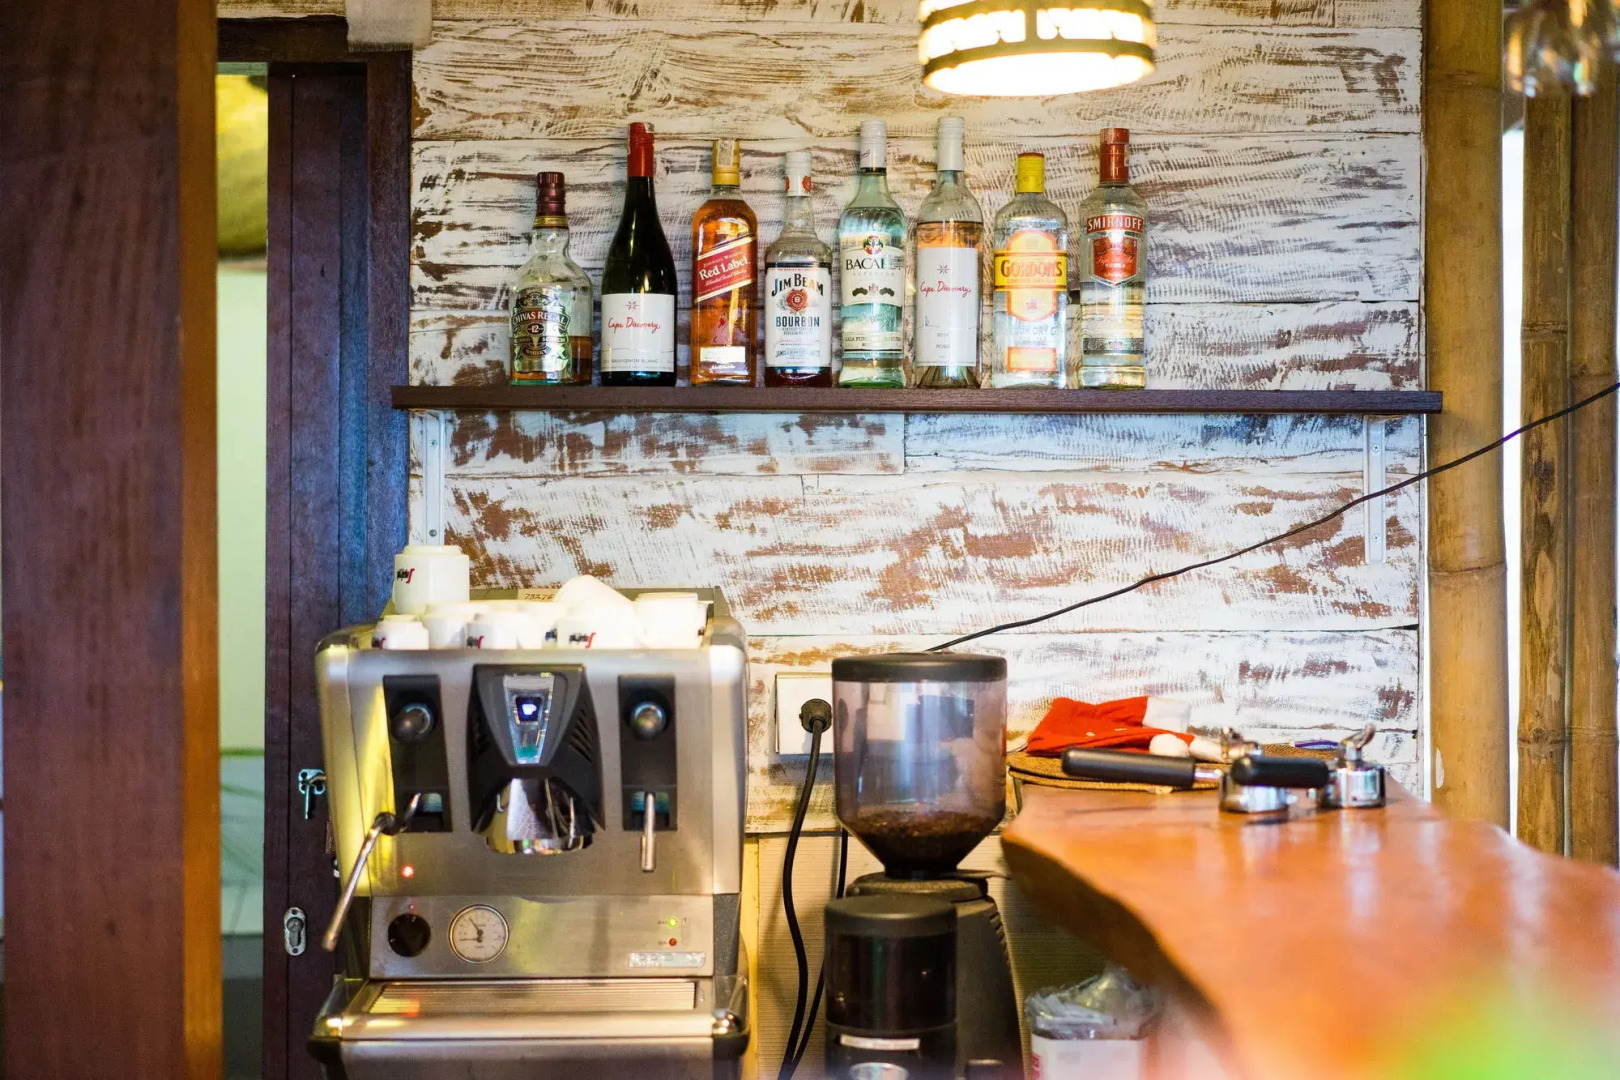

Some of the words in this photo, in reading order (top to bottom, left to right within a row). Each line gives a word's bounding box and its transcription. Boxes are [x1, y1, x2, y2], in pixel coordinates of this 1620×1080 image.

[1088, 216, 1143, 231] SMIRNOFF
[699, 265, 721, 281] Red
[720, 255, 749, 273] Label
[846, 257, 900, 270] BACA
[771, 278, 792, 297] JIM
[793, 273, 824, 297] BEAM
[920, 281, 935, 298] Cape
[936, 280, 972, 299] Discovery
[512, 311, 536, 326] CHIVAS
[608, 317, 624, 334] Cape
[626, 316, 661, 335] Discovery
[775, 316, 820, 328] BOURBON
[531, 324, 540, 334] 12
